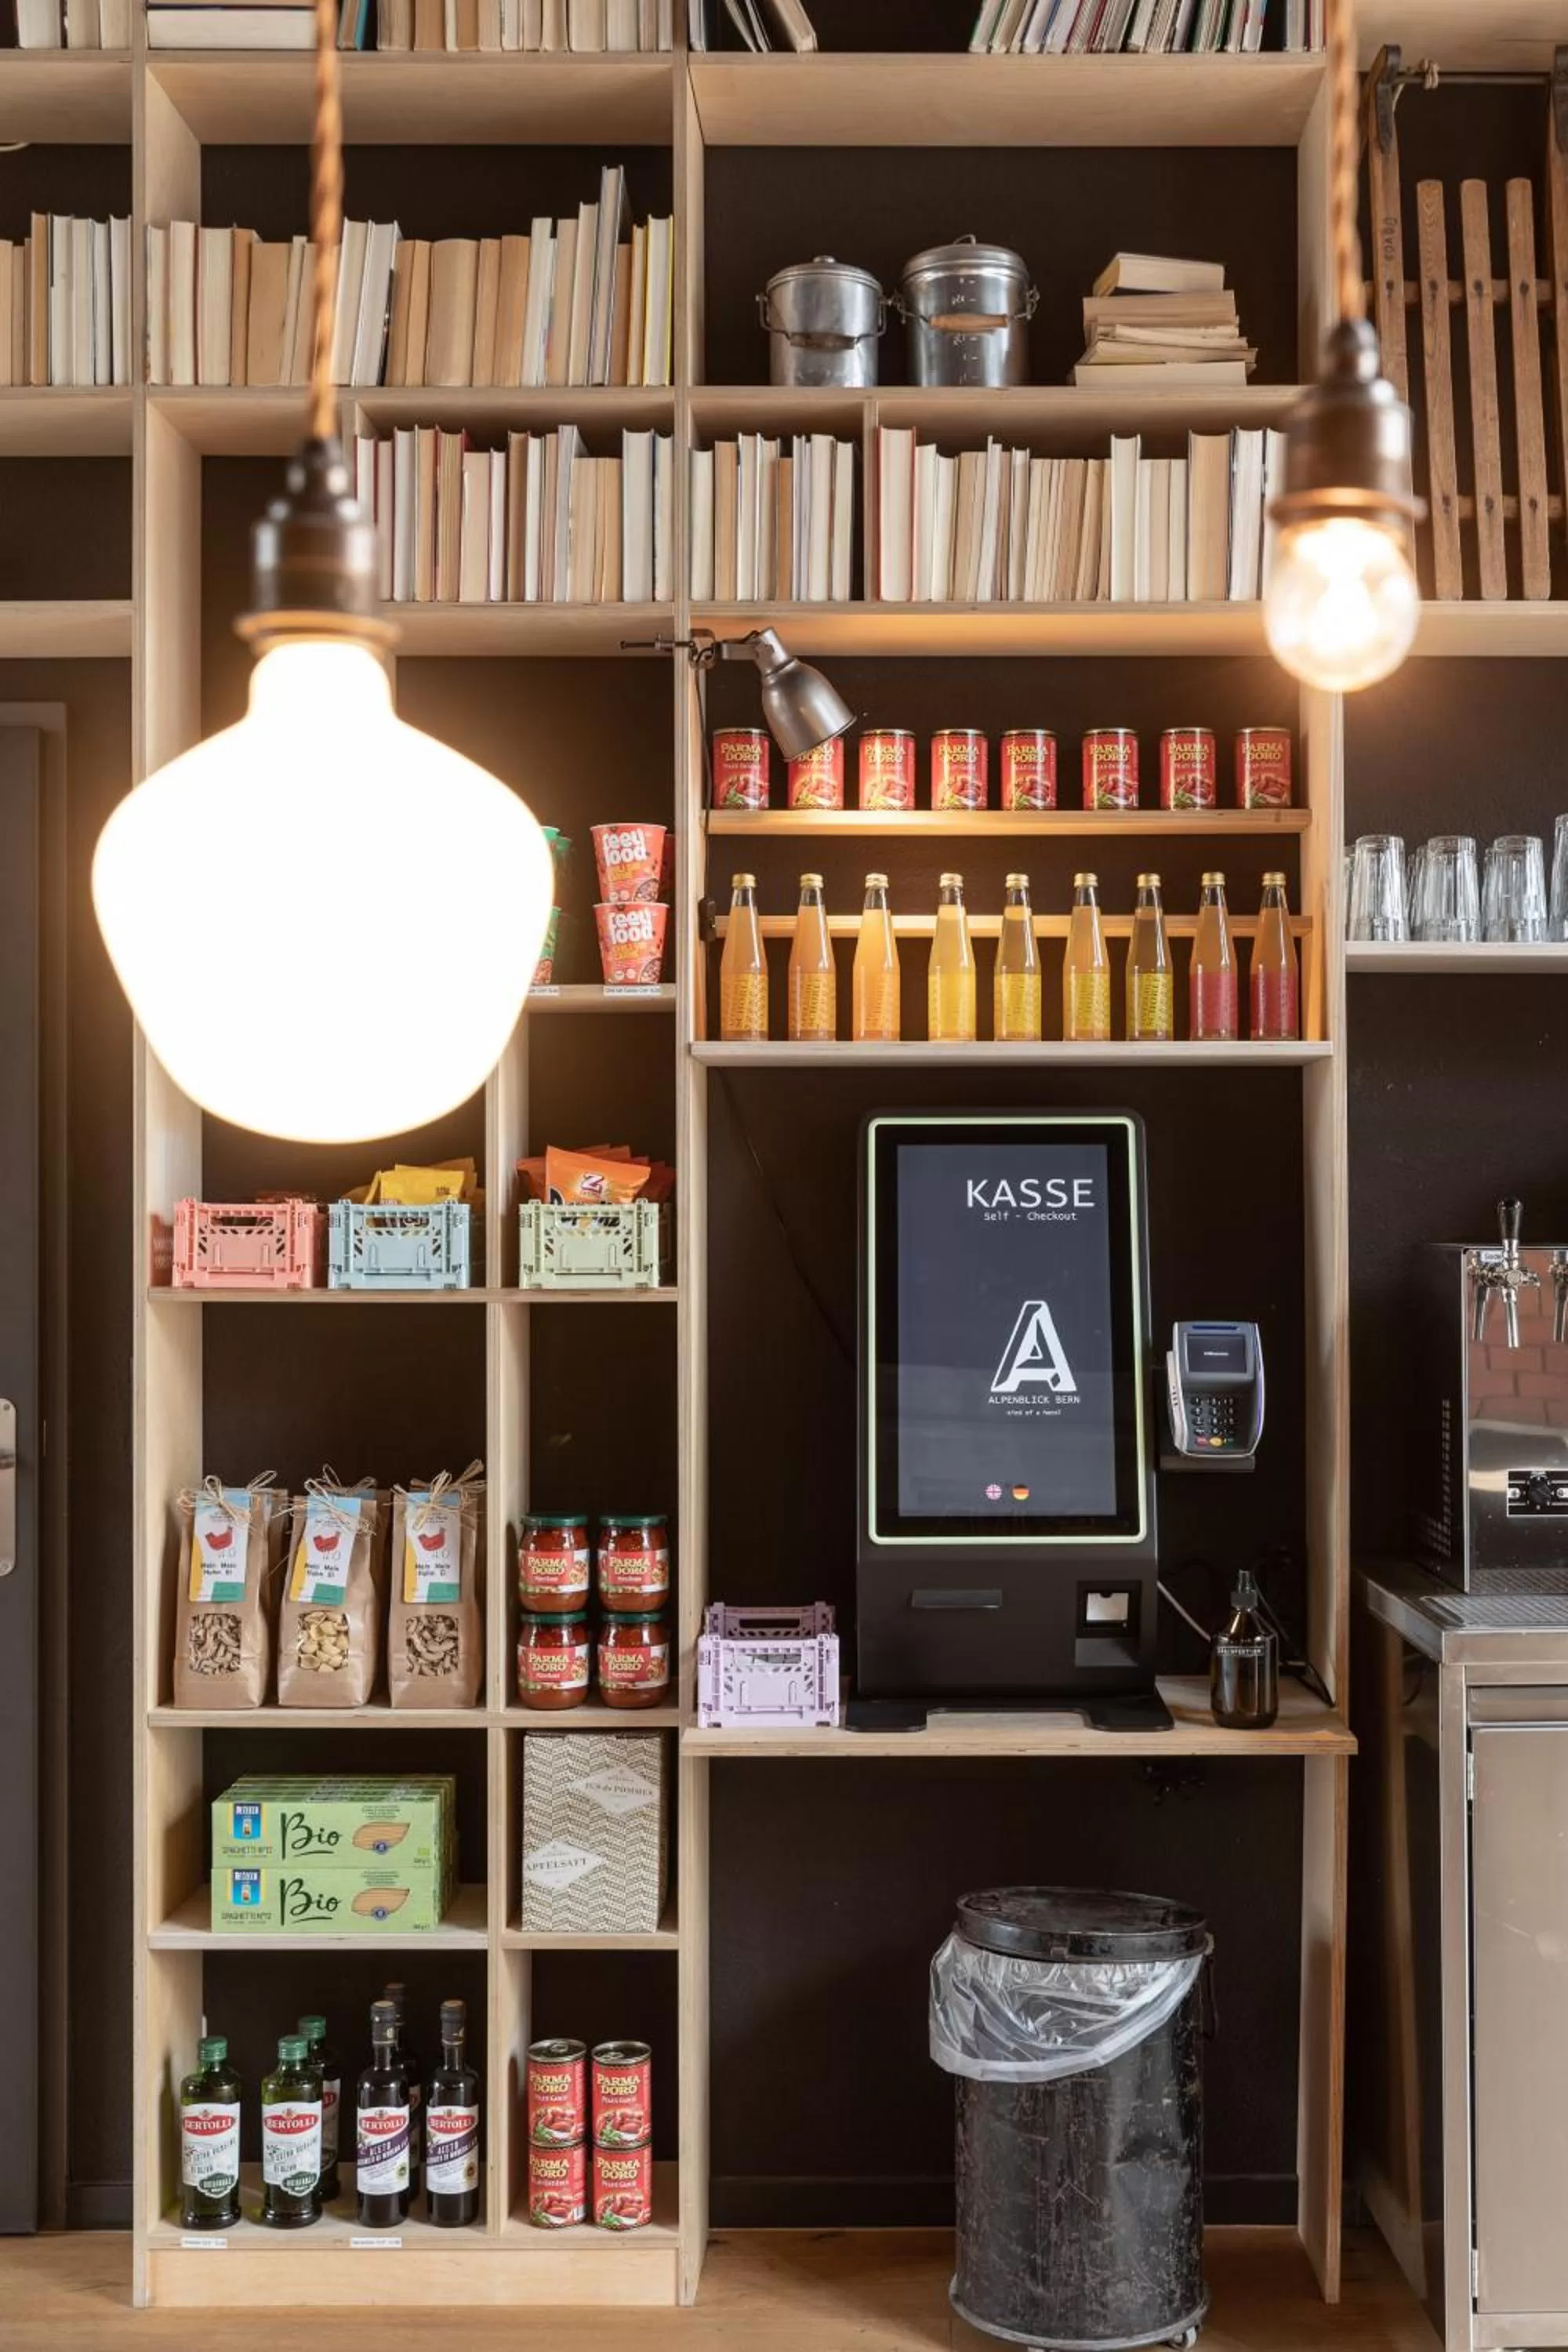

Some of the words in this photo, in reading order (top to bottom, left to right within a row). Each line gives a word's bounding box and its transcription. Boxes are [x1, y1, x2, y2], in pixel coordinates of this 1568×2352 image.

[721, 742, 762, 753] PARMA
[1090, 745, 1131, 755] PARMA
[1168, 742, 1210, 753] PARMA
[1242, 742, 1283, 753] PARMA
[725, 752, 760, 761] DORO
[1095, 753, 1128, 761] DORO
[1173, 752, 1207, 760] DORO
[1247, 752, 1280, 760] DORO
[967, 1178, 1095, 1208] KASSE
[984, 1210, 1008, 1221] Self
[1027, 1210, 1078, 1221] Checkout
[990, 1300, 1077, 1392] A
[989, 1395, 1050, 1404] ALPENBLICK
[1054, 1395, 1081, 1404] BERN
[528, 1556, 568, 1566] PARMA
[609, 1556, 650, 1567] PARMA
[532, 1566, 564, 1575] DORO
[614, 1566, 648, 1575] DORO
[528, 1653, 569, 1663] PARMA
[604, 1652, 644, 1663] PARMA
[532, 1662, 566, 1671] DORO
[608, 1662, 641, 1671] DORO
[280, 1812, 343, 1860] Bio
[526, 1858, 586, 1871] APFELSAFT
[279, 1878, 341, 1926] Bio
[596, 2073, 640, 2085] PARMA
[601, 2085, 637, 2095] DORO
[185, 2118, 232, 2129] BERTOLLI
[266, 2117, 314, 2129] BERTOLLI
[361, 2118, 404, 2129] BERTOLLI
[430, 2117, 471, 2129] BERTOLLI
[596, 2157, 641, 2169] PARMA
[533, 2168, 567, 2177] DORO
[601, 2169, 638, 2179] DORO
